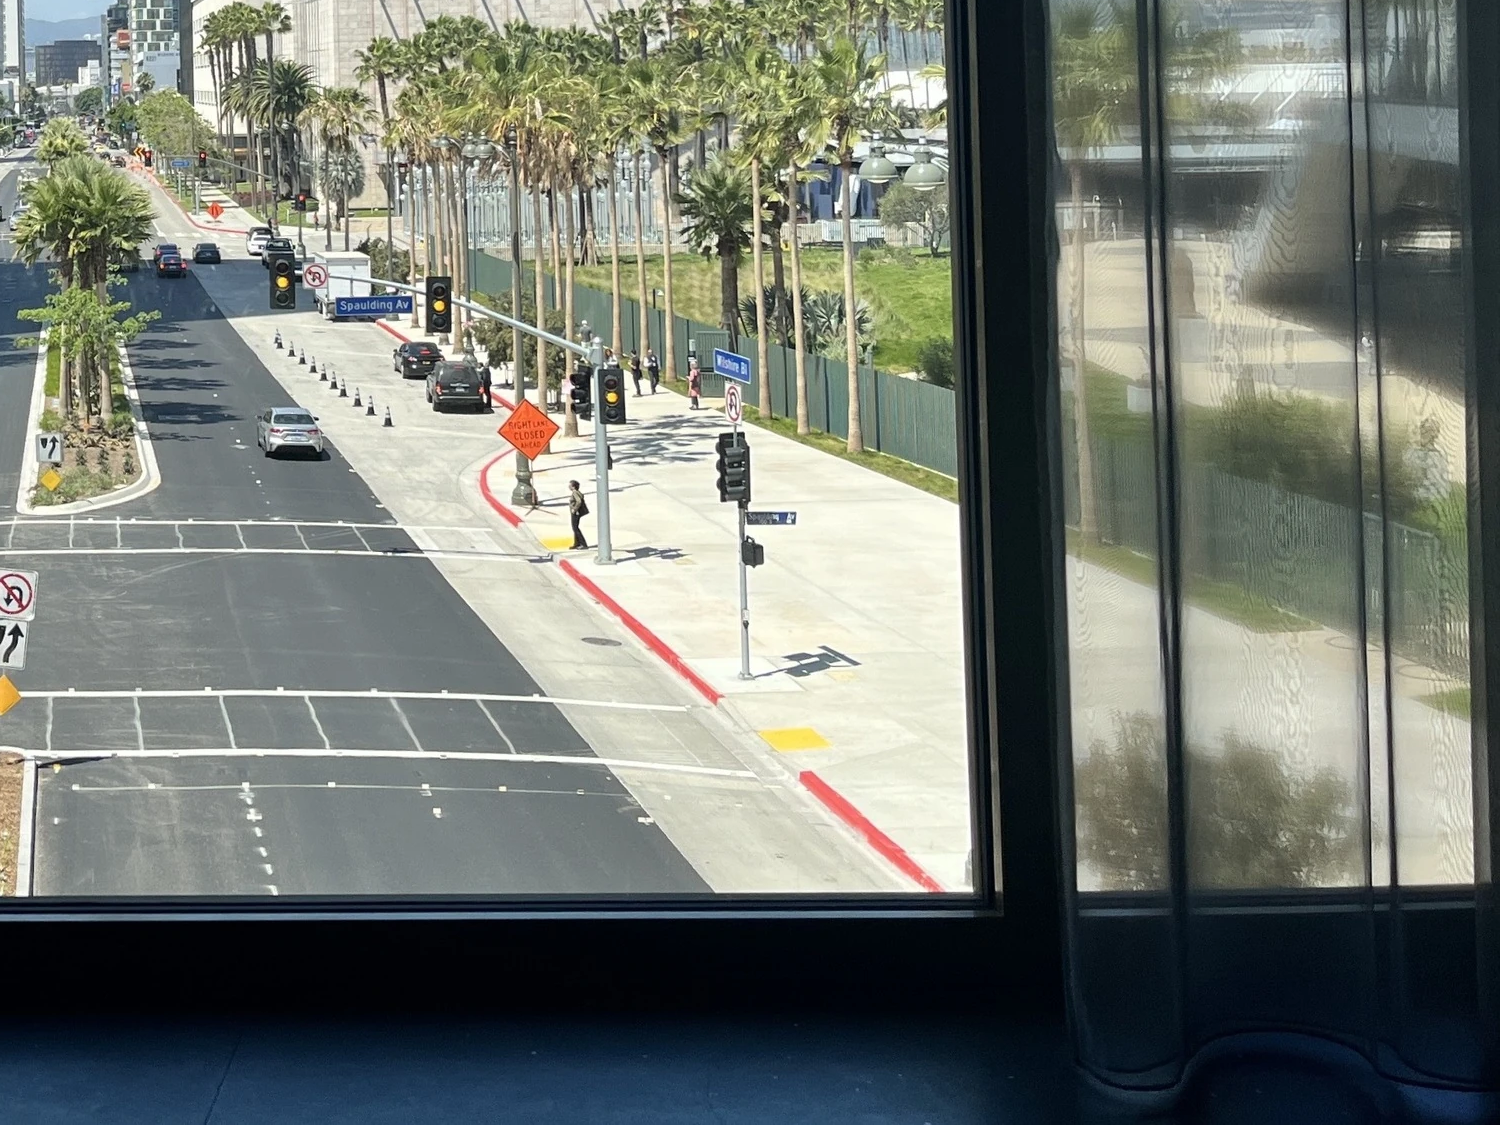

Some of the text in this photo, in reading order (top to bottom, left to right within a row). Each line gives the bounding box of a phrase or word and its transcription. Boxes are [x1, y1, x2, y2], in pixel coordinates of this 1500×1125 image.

[340, 299, 409, 312] Spaulding Av
[508, 420, 532, 429] RIGHT
[514, 430, 545, 440] CLOSED
